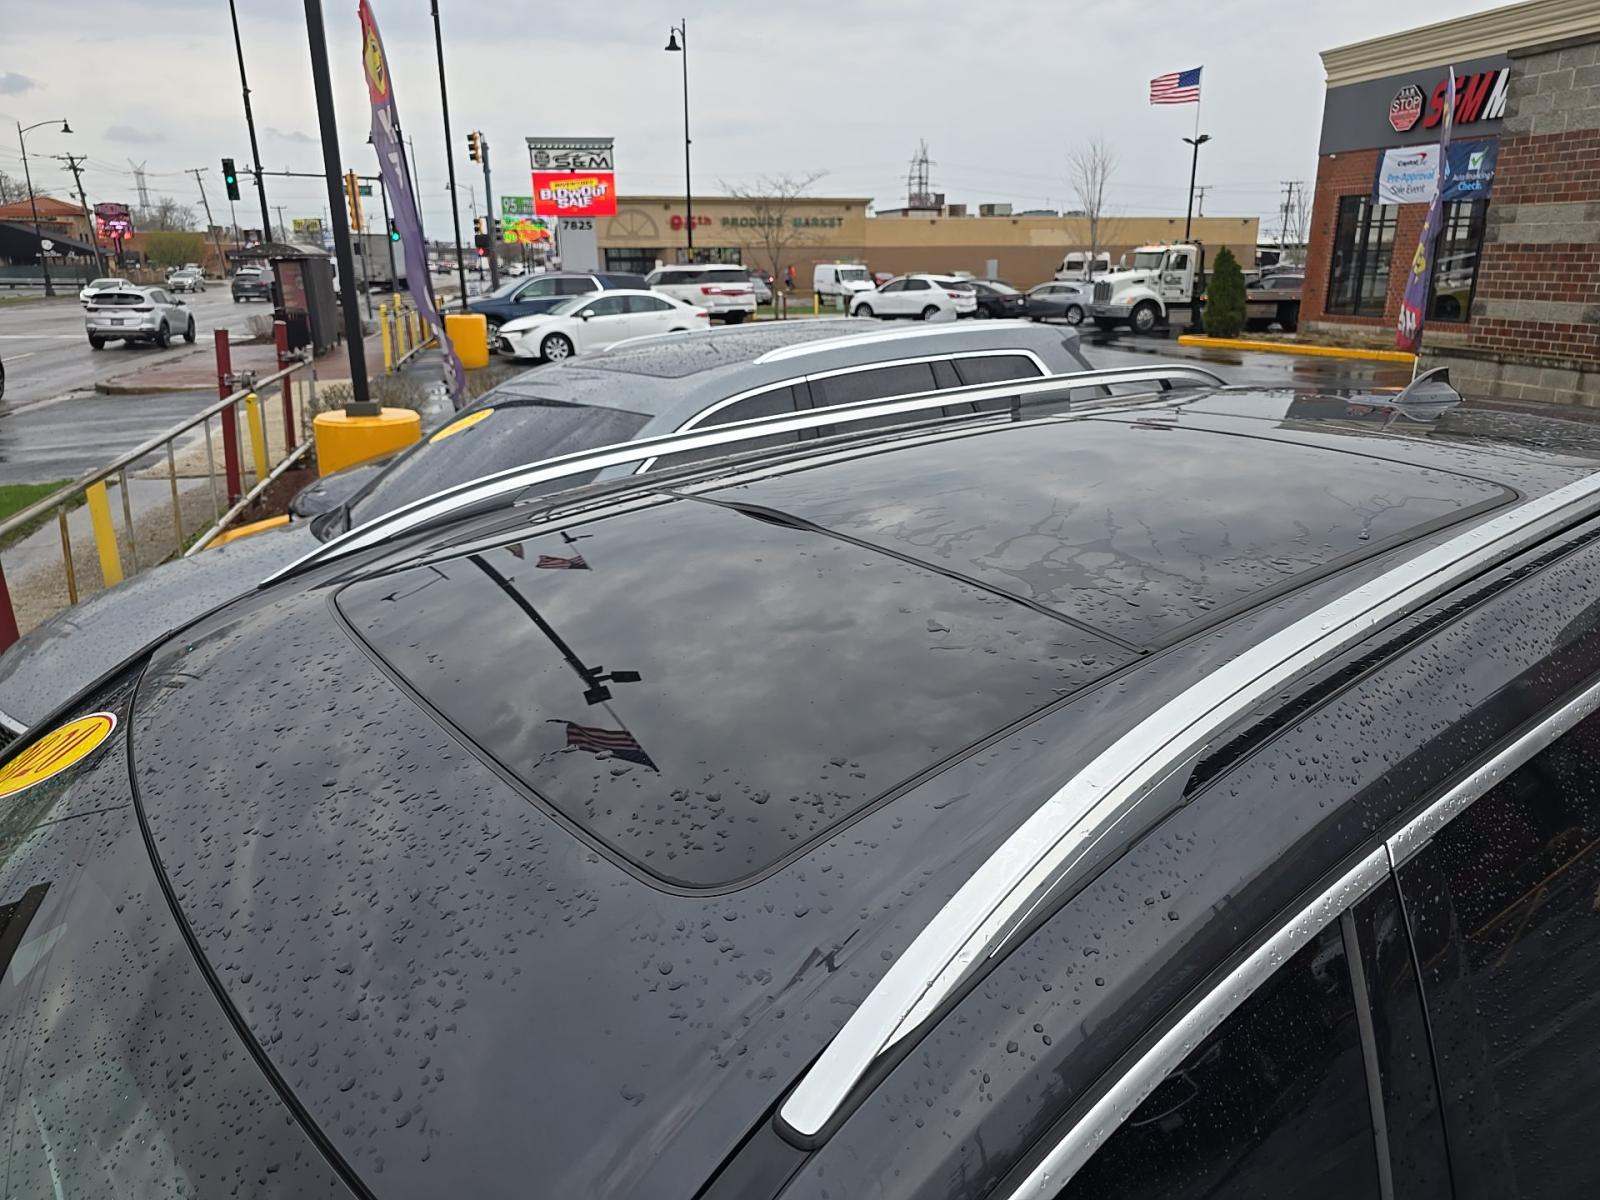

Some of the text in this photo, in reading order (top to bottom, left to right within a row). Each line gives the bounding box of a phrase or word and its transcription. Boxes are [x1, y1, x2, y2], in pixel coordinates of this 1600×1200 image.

[1391, 96, 1421, 113] STOP
[540, 183, 609, 201] BLOWOUT
[557, 196, 593, 209] SALE
[720, 215, 784, 228] PRODUCE
[792, 215, 845, 228] MARKET
